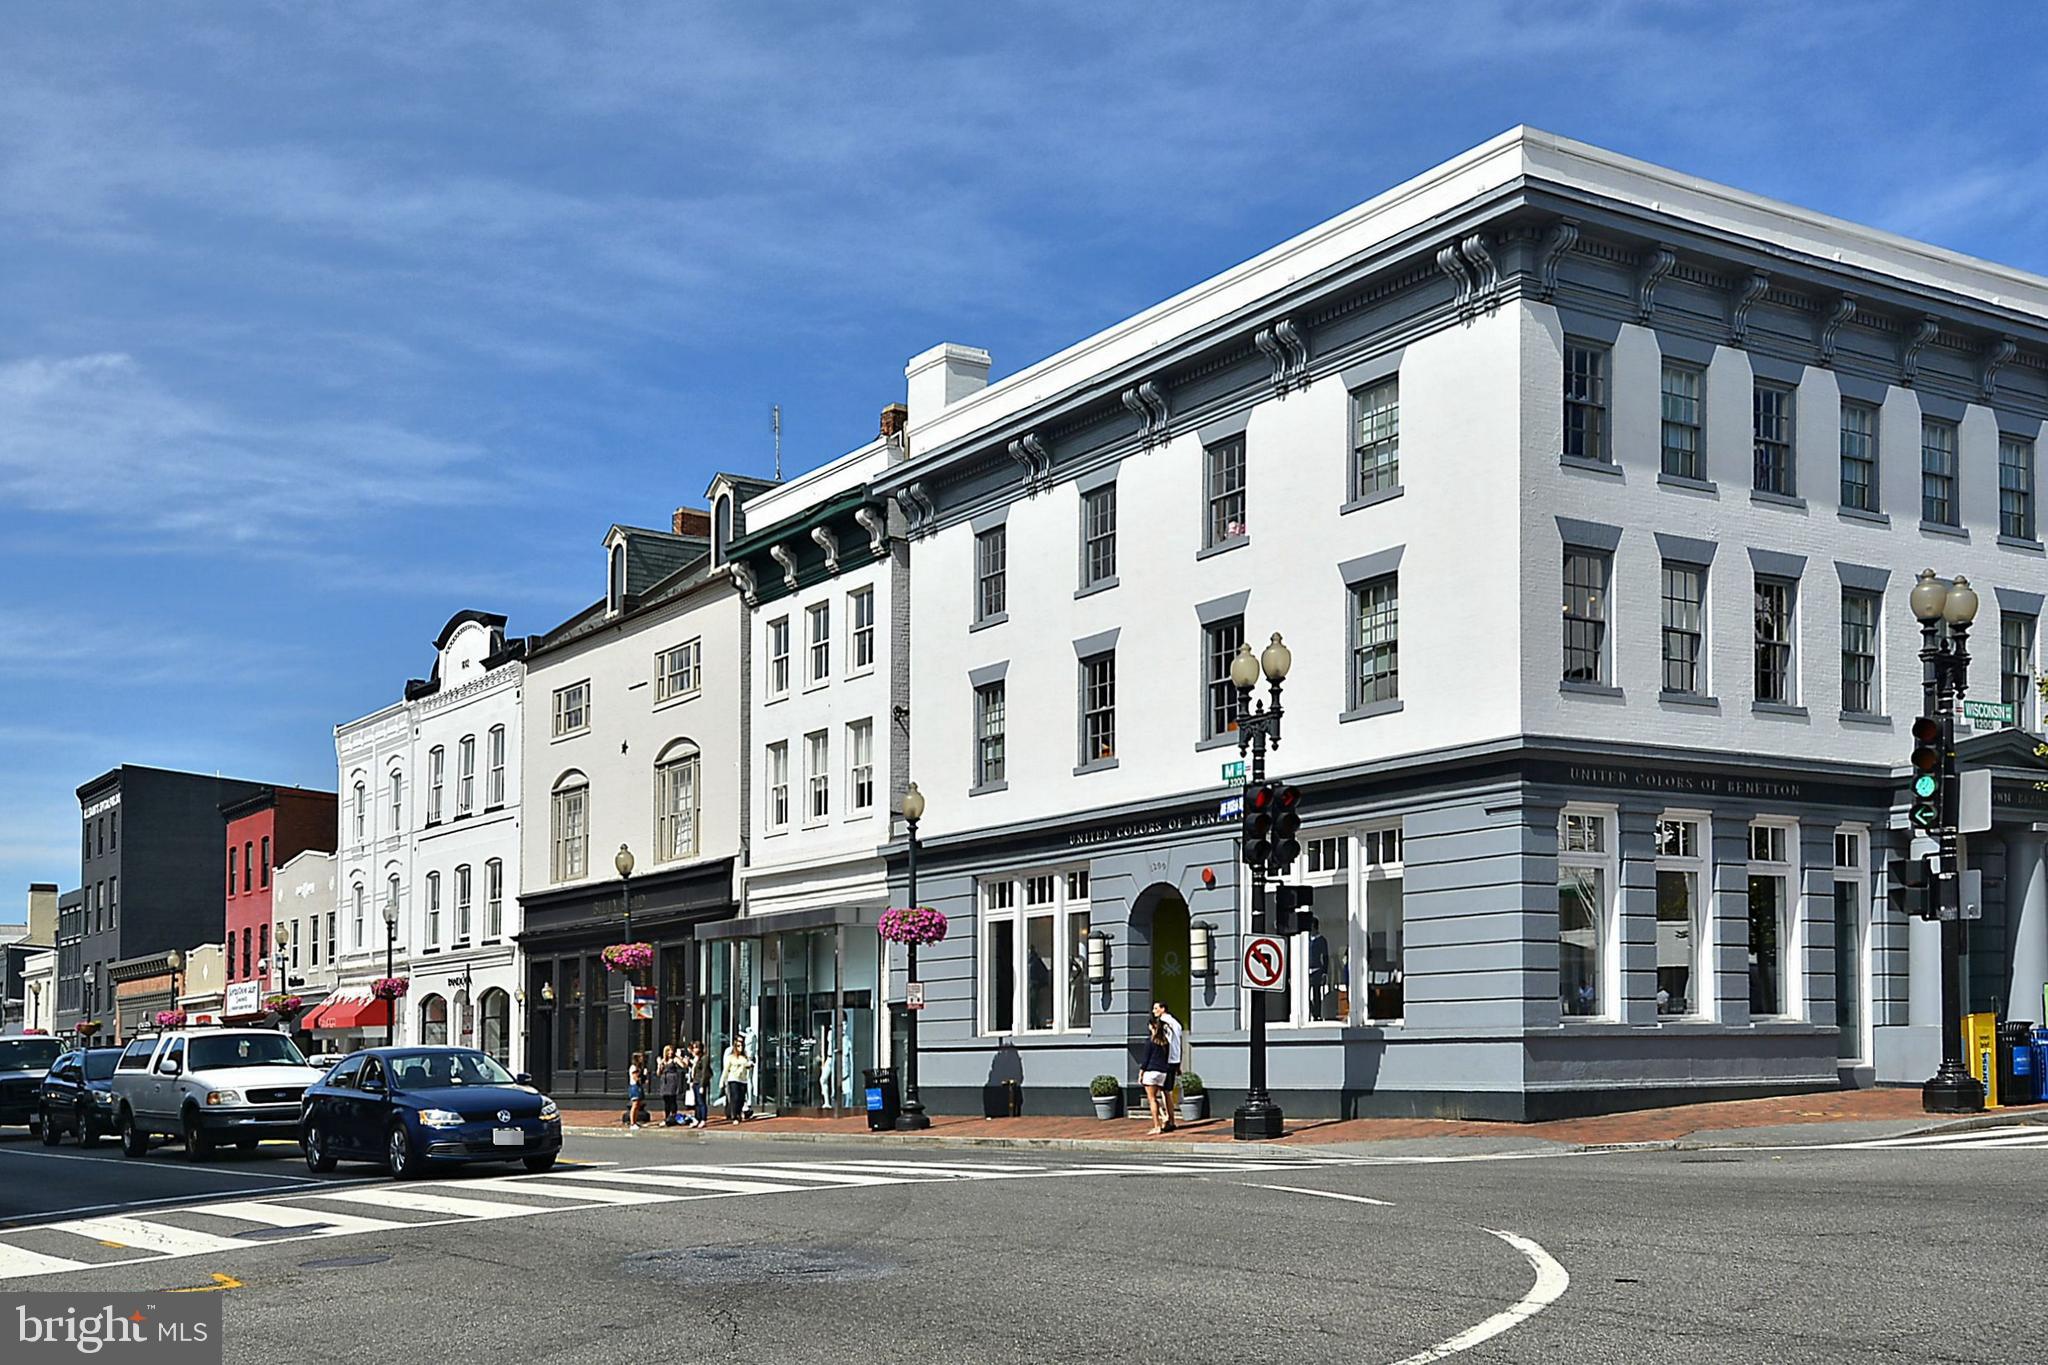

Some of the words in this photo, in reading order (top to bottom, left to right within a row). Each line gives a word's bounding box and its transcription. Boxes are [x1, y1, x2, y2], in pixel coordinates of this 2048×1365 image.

[1965, 701, 2006, 719] WISCONSIN
[1225, 764, 1235, 778] M
[1230, 776, 1245, 788] 3200
[1570, 767, 1627, 784] UNITED
[1635, 773, 1694, 789] COLORS
[1701, 779, 1718, 791] OF
[1727, 780, 1801, 796] BENETTON
[1069, 828, 1111, 845] UNITED
[1116, 820, 1162, 838] COLORS
[1168, 817, 1183, 830] OF
[1191, 811, 1243, 827] BENETT
